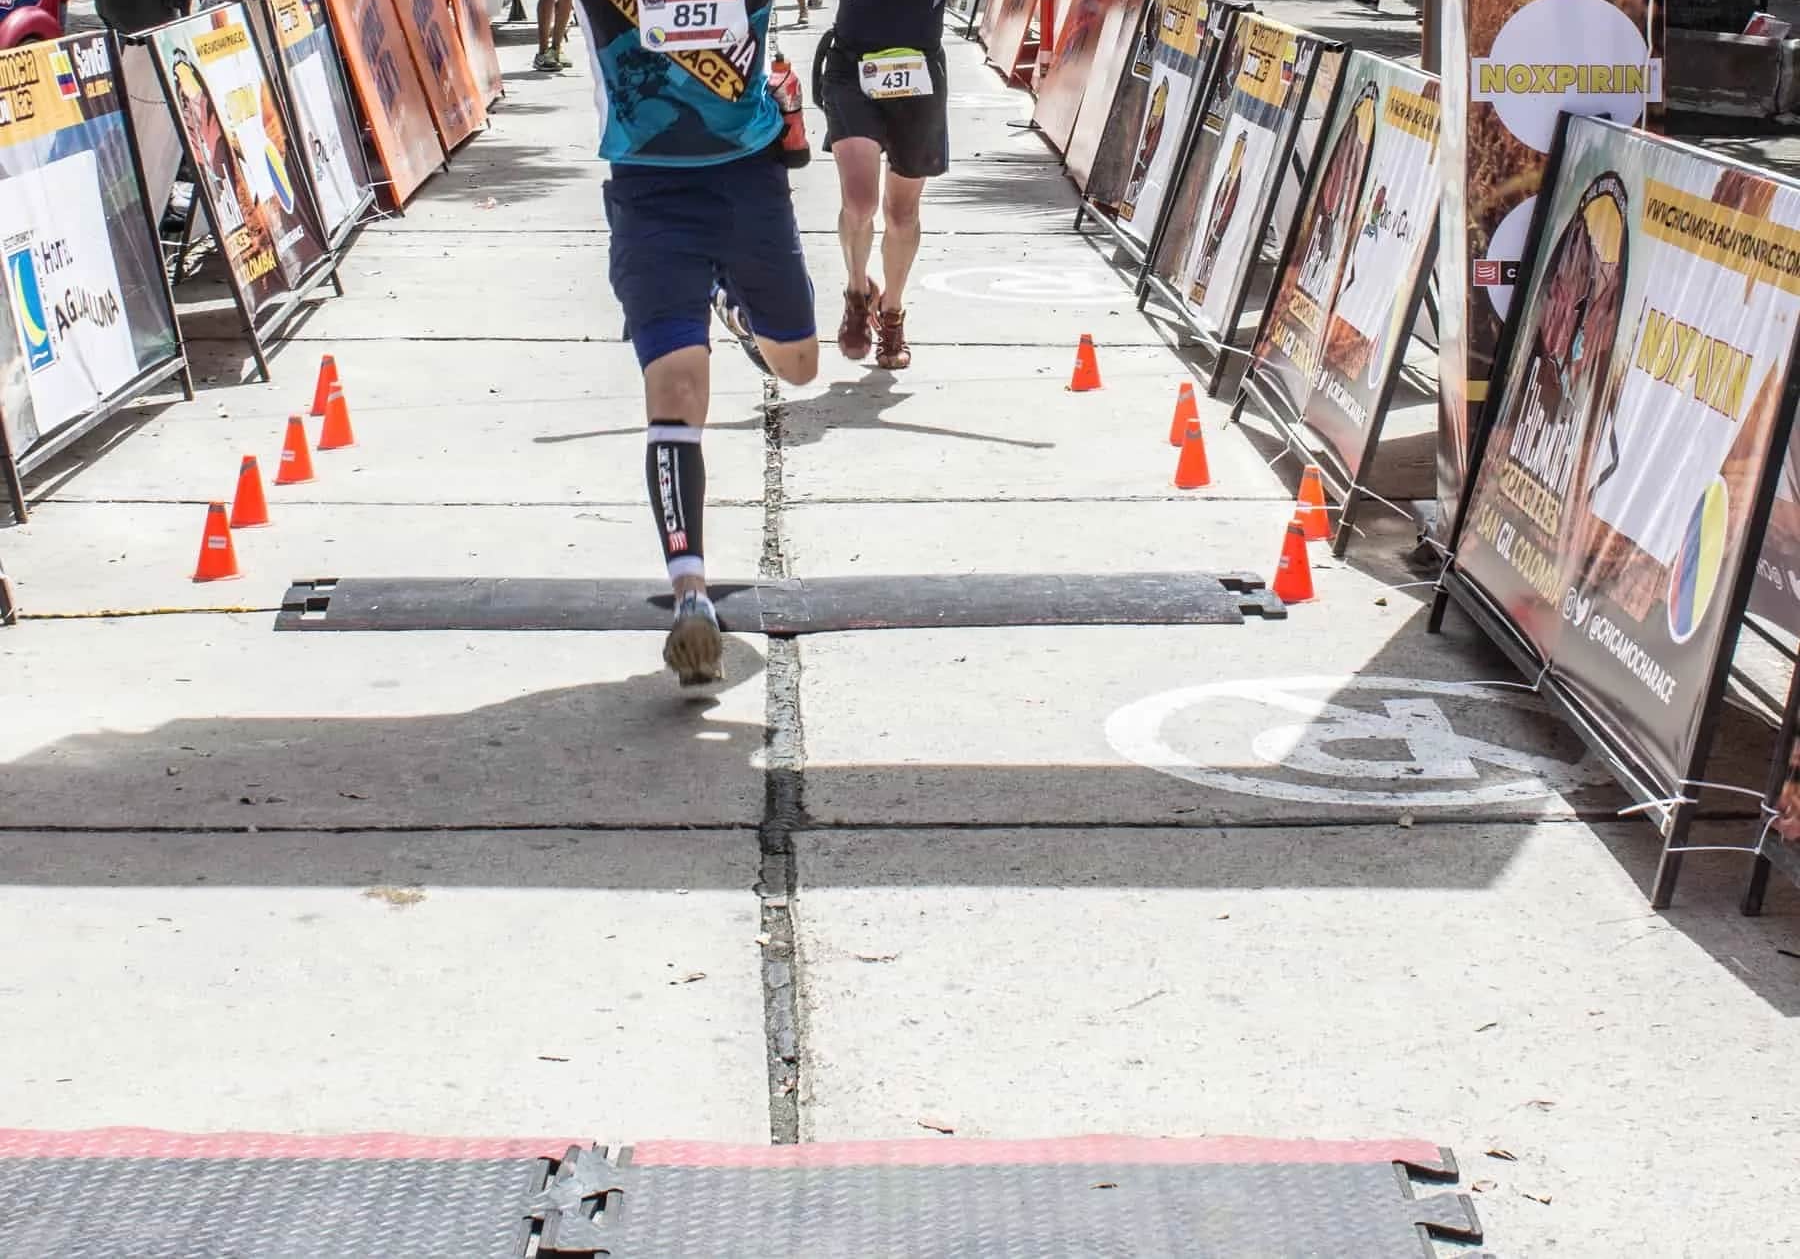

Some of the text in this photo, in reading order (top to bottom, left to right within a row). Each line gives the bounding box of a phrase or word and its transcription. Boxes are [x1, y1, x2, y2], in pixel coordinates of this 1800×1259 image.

[673, 3, 718, 27] 851
[881, 71, 911, 88] 431
[1479, 64, 1651, 94] NOXPIRIN
